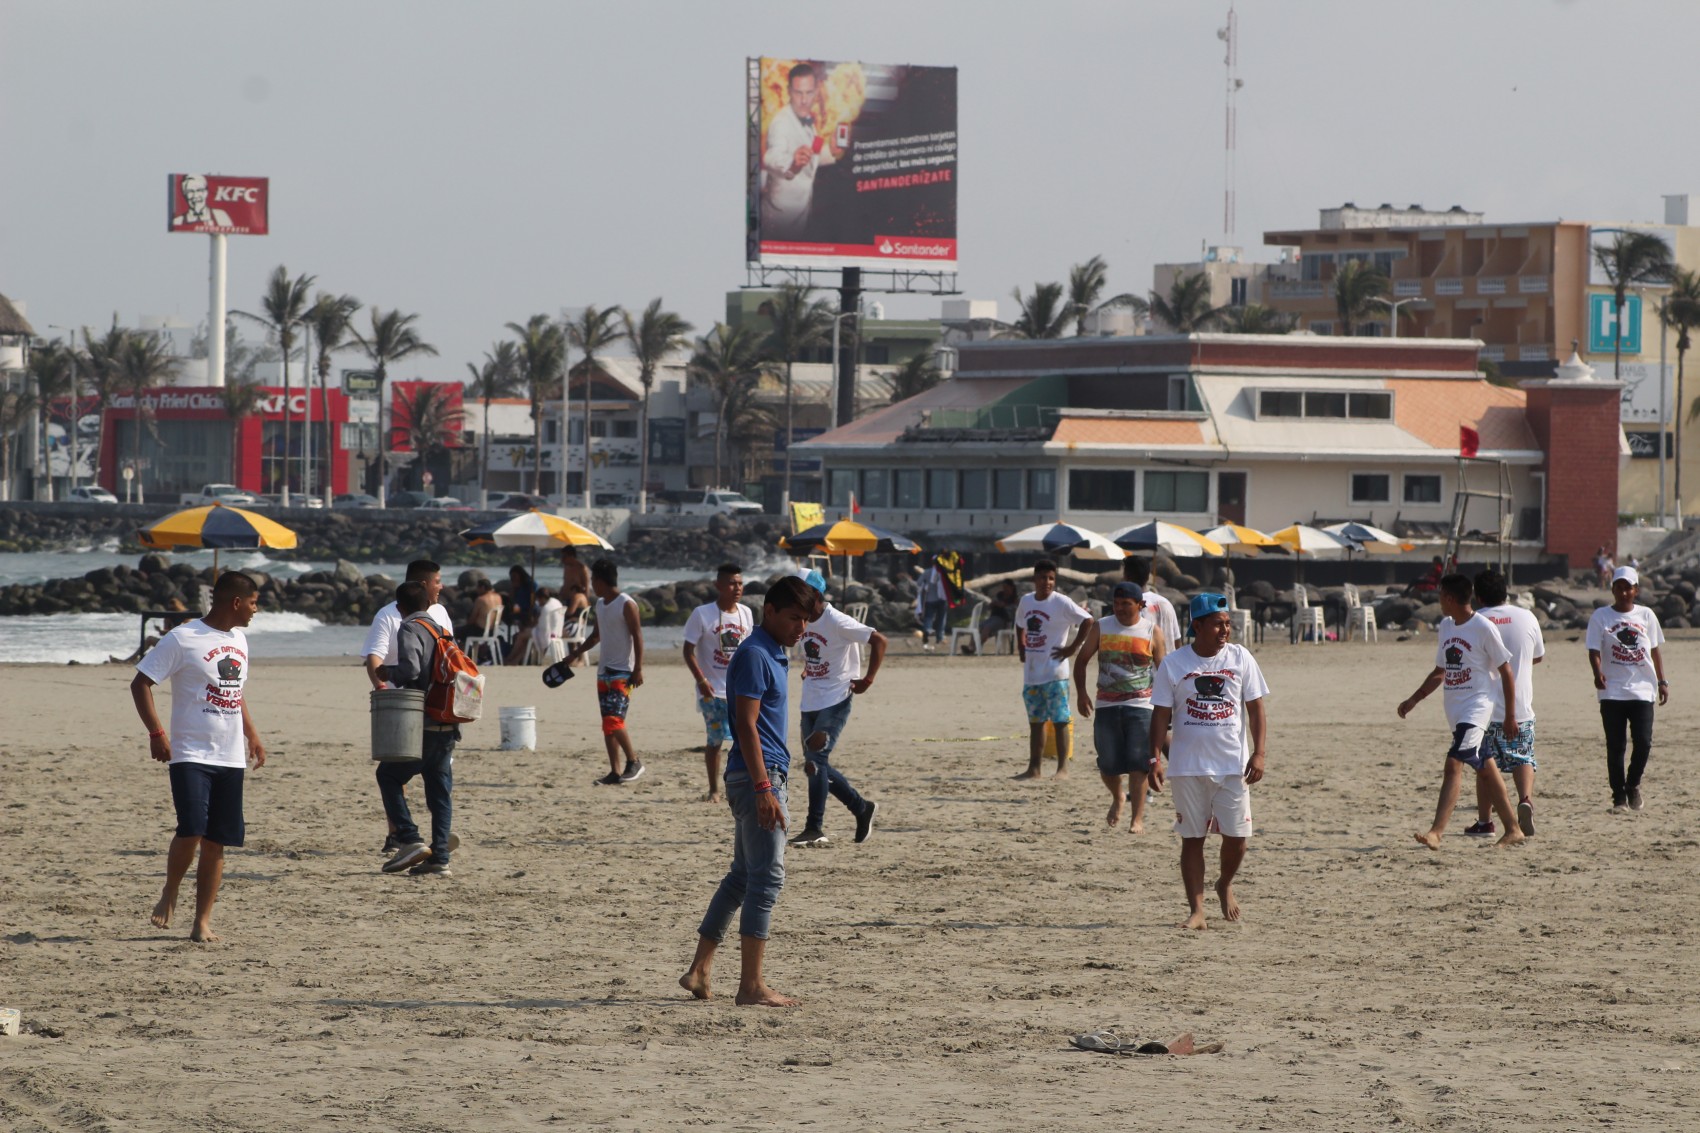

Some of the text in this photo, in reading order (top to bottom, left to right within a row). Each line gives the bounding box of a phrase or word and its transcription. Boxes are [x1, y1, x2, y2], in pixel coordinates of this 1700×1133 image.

[853, 154, 862, 162] de
[852, 165, 862, 174] de
[856, 169, 952, 192] SANTANDERÍZATE
[214, 186, 260, 203] KFC
[894, 242, 950, 257] Santander
[1601, 300, 1630, 338] H
[109, 393, 159, 409] Kentcky
[160, 393, 189, 409] Fried
[252, 395, 307, 413] KFC
[1489, 616, 1512, 625] MANUEL
[203, 647, 221, 662] LIFE
[205, 683, 231, 697] RALLY
[1185, 698, 1209, 710] RALLY
[1187, 705, 1235, 721] VERACRUZ
